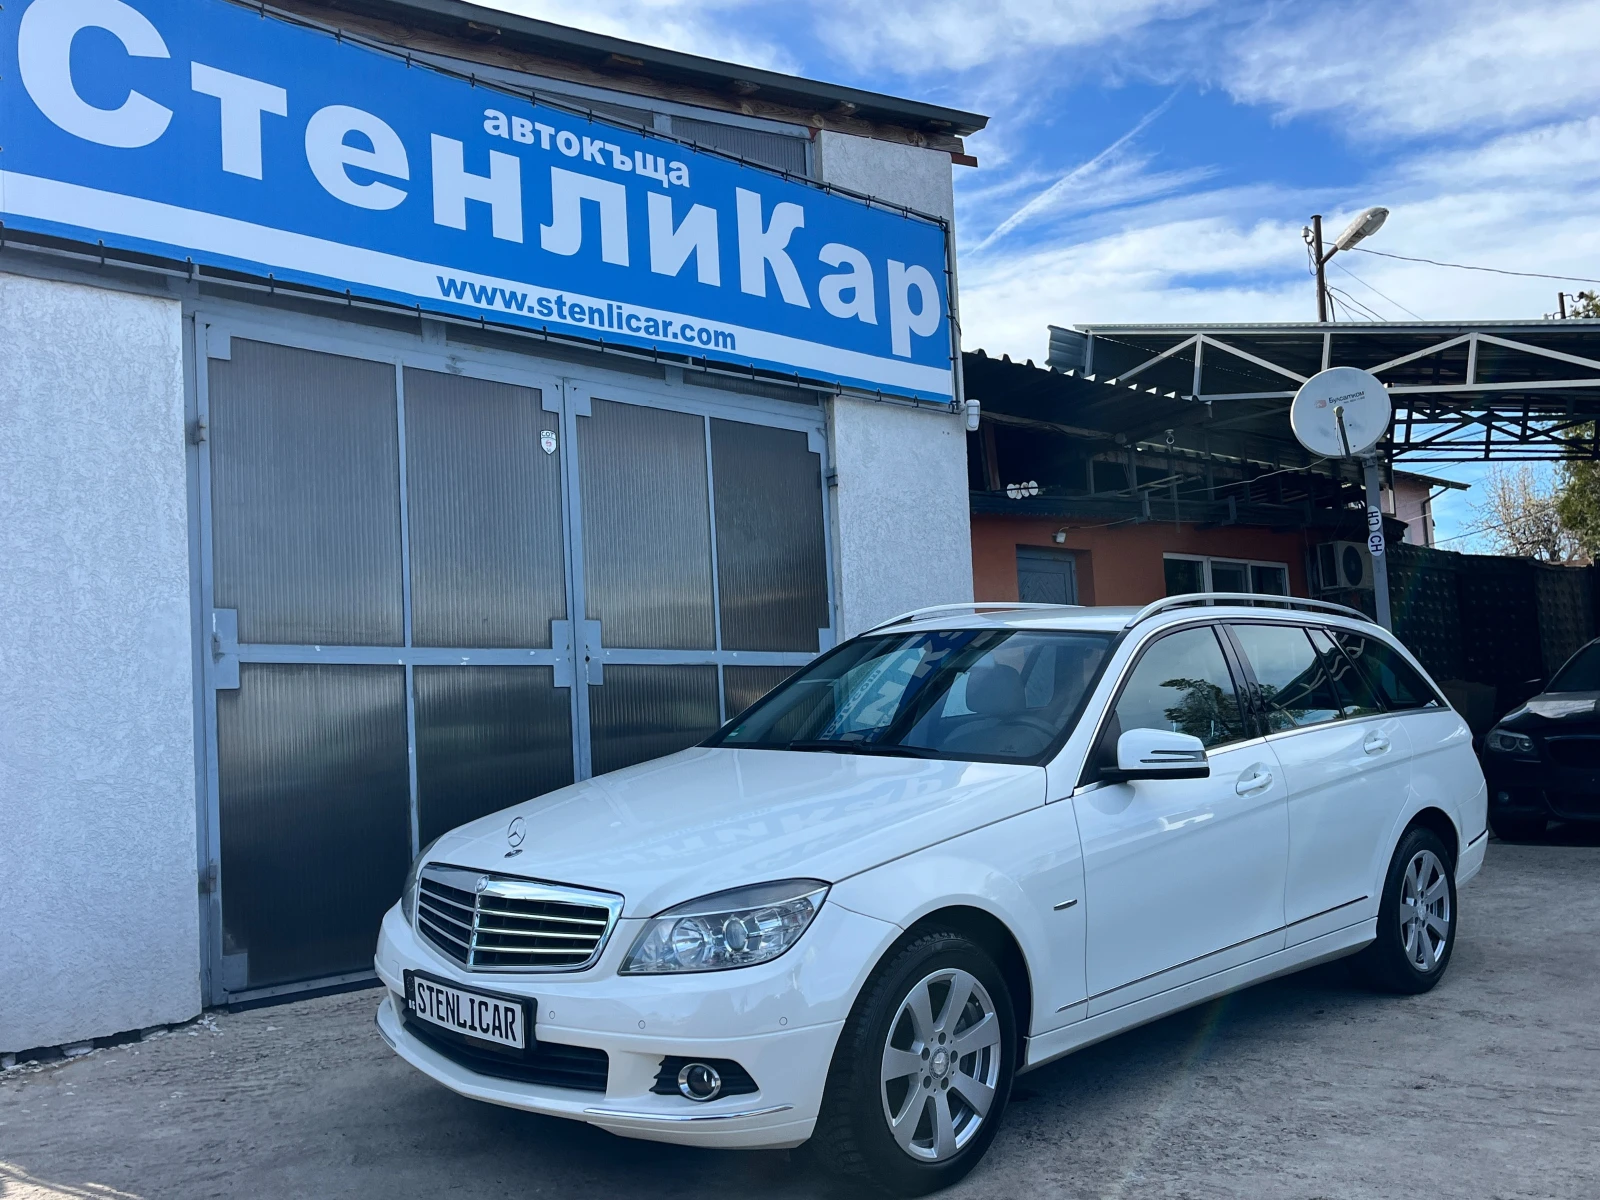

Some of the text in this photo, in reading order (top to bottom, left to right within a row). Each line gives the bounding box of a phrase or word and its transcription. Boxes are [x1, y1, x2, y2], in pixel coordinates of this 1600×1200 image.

[17, 0, 942, 359] СтенлиКар
[483, 108, 690, 189] автокъща
[436, 275, 737, 351] www.stenlicar.com
[1370, 535, 1383, 552] CH
[417, 982, 517, 1042] STENLICAR
